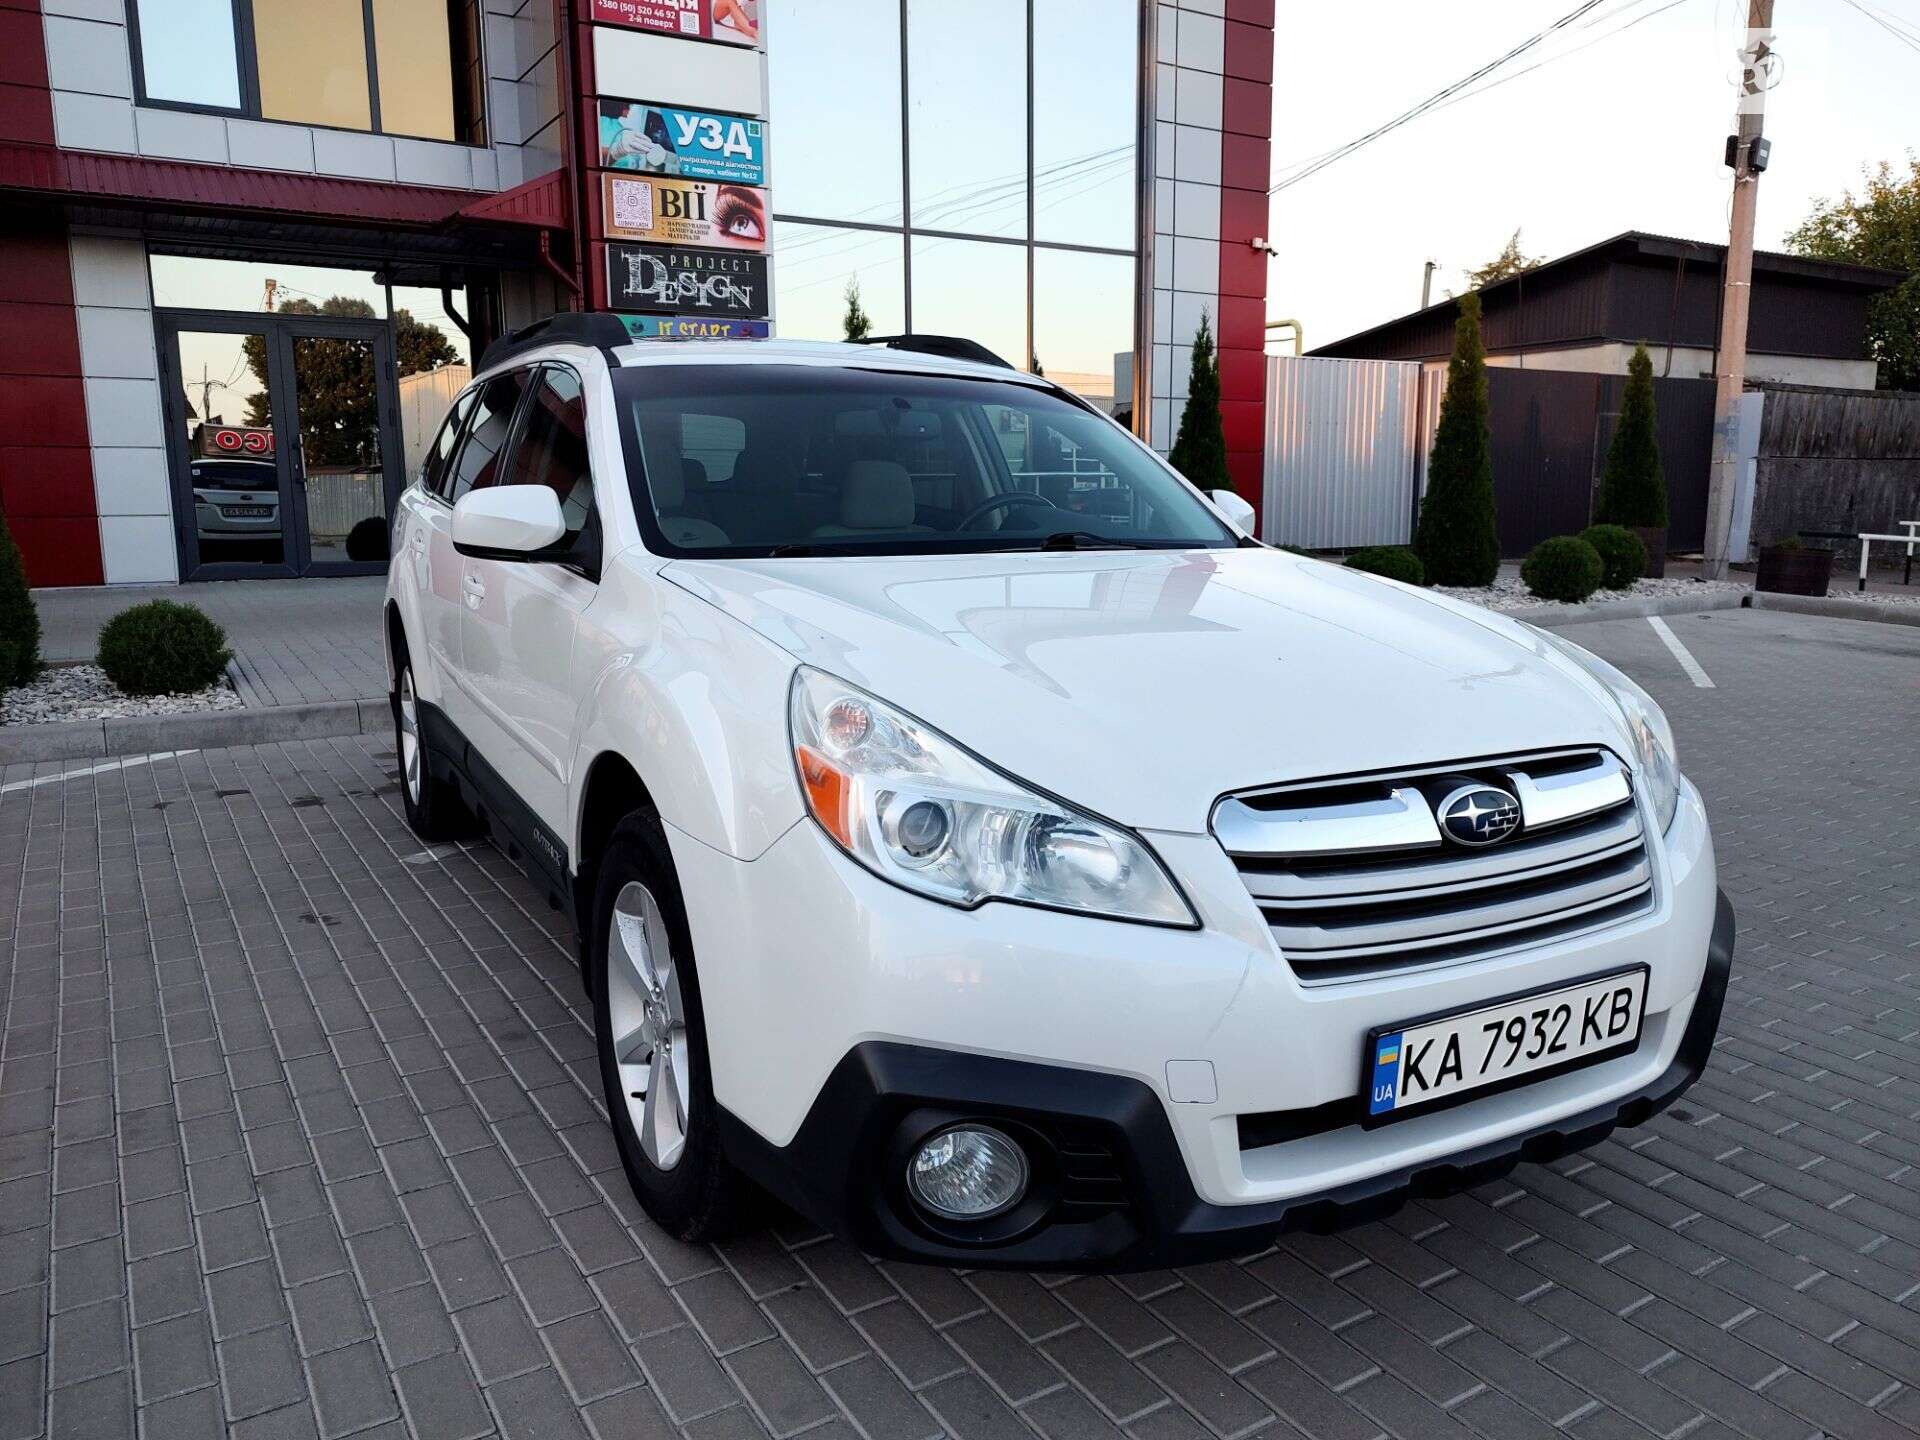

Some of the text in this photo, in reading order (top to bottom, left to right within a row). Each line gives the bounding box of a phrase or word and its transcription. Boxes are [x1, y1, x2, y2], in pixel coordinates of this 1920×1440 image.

[598, 0, 676, 19] +380 (50) 520 46 92
[644, 18, 674, 29] поверх
[674, 113, 753, 160] УЗД
[658, 184, 709, 221] ВІЇ
[671, 254, 751, 271] PROJECT
[622, 249, 753, 310] DESIGN
[1401, 987, 1633, 1097] KA 7932 KB
[1374, 1084, 1394, 1102] UA
